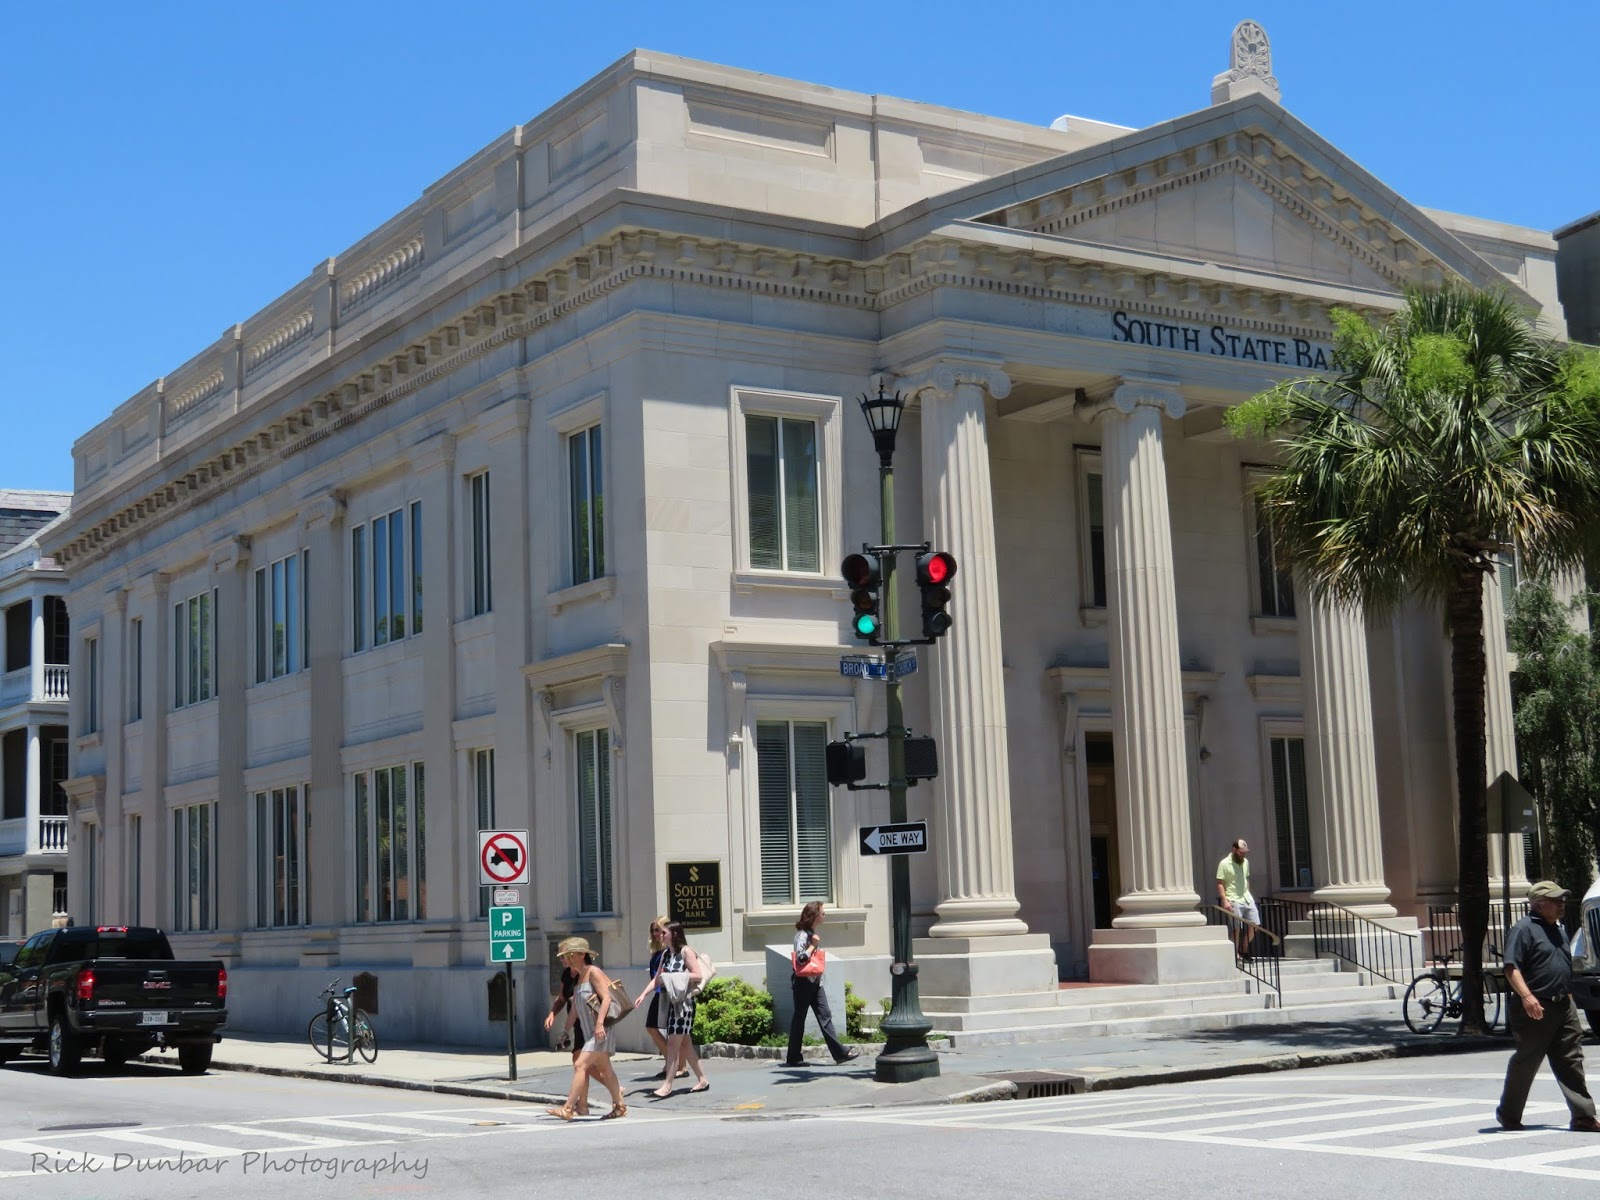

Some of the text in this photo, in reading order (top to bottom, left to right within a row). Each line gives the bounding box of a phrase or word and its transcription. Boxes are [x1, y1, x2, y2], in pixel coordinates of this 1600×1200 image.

[1113, 311, 1347, 373] SOUTH STATE BA
[842, 662, 870, 675] BROAD
[880, 832, 920, 846] ONE WAY
[674, 883, 715, 897] SOUTH
[677, 898, 713, 912] STATE
[502, 911, 513, 927] P
[493, 929, 522, 938] PARKING
